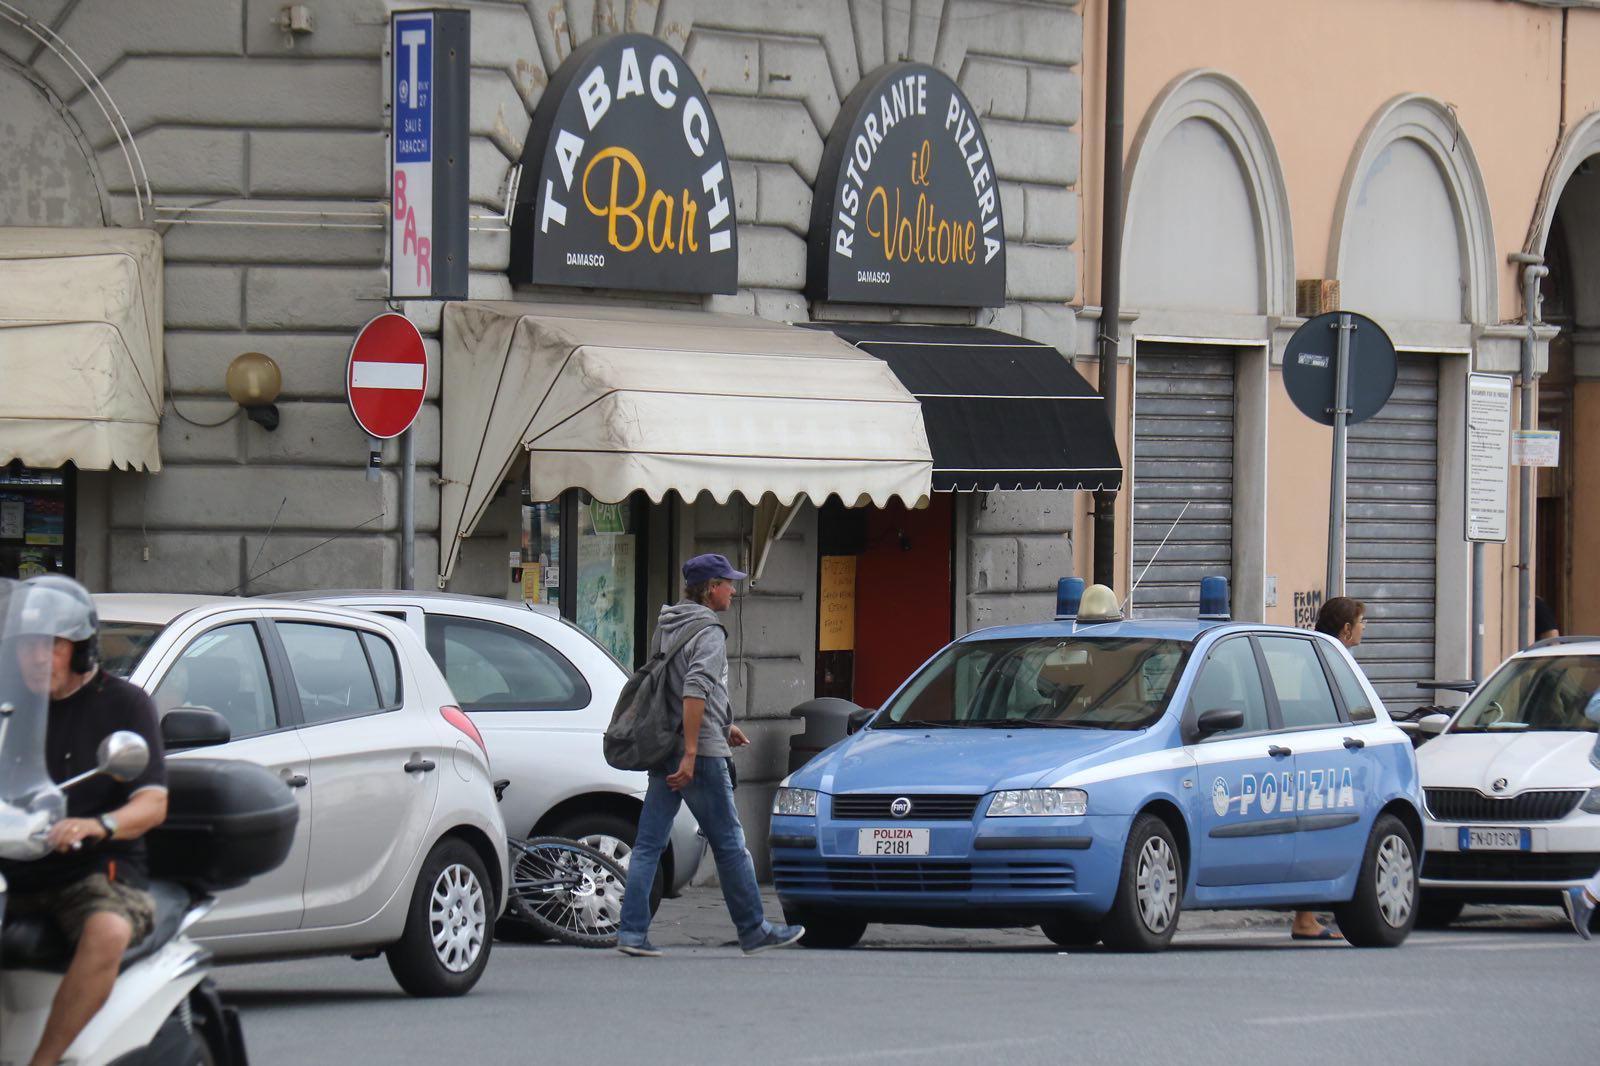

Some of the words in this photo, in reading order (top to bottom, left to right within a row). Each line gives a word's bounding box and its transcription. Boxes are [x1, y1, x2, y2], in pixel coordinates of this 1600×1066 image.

[402, 30, 426, 109] T
[405, 119, 417, 133] SALI
[399, 140, 428, 153] TABACCHI
[541, 47, 731, 253] TABACCHI
[836, 75, 927, 259] RISTORANTE
[945, 93, 1000, 265] PIZZERIA
[582, 146, 698, 255] Bar
[395, 170, 431, 288] BAR
[866, 185, 976, 265] Voltone
[566, 253, 605, 267] DAMASCO
[857, 271, 891, 284] DAMASCO
[1293, 590, 1321, 607] PROM
[1239, 767, 1355, 816] POLIZIA
[893, 803, 907, 811] FIAT
[873, 829, 913, 839] POLIZIA
[876, 840, 910, 855] F2181
